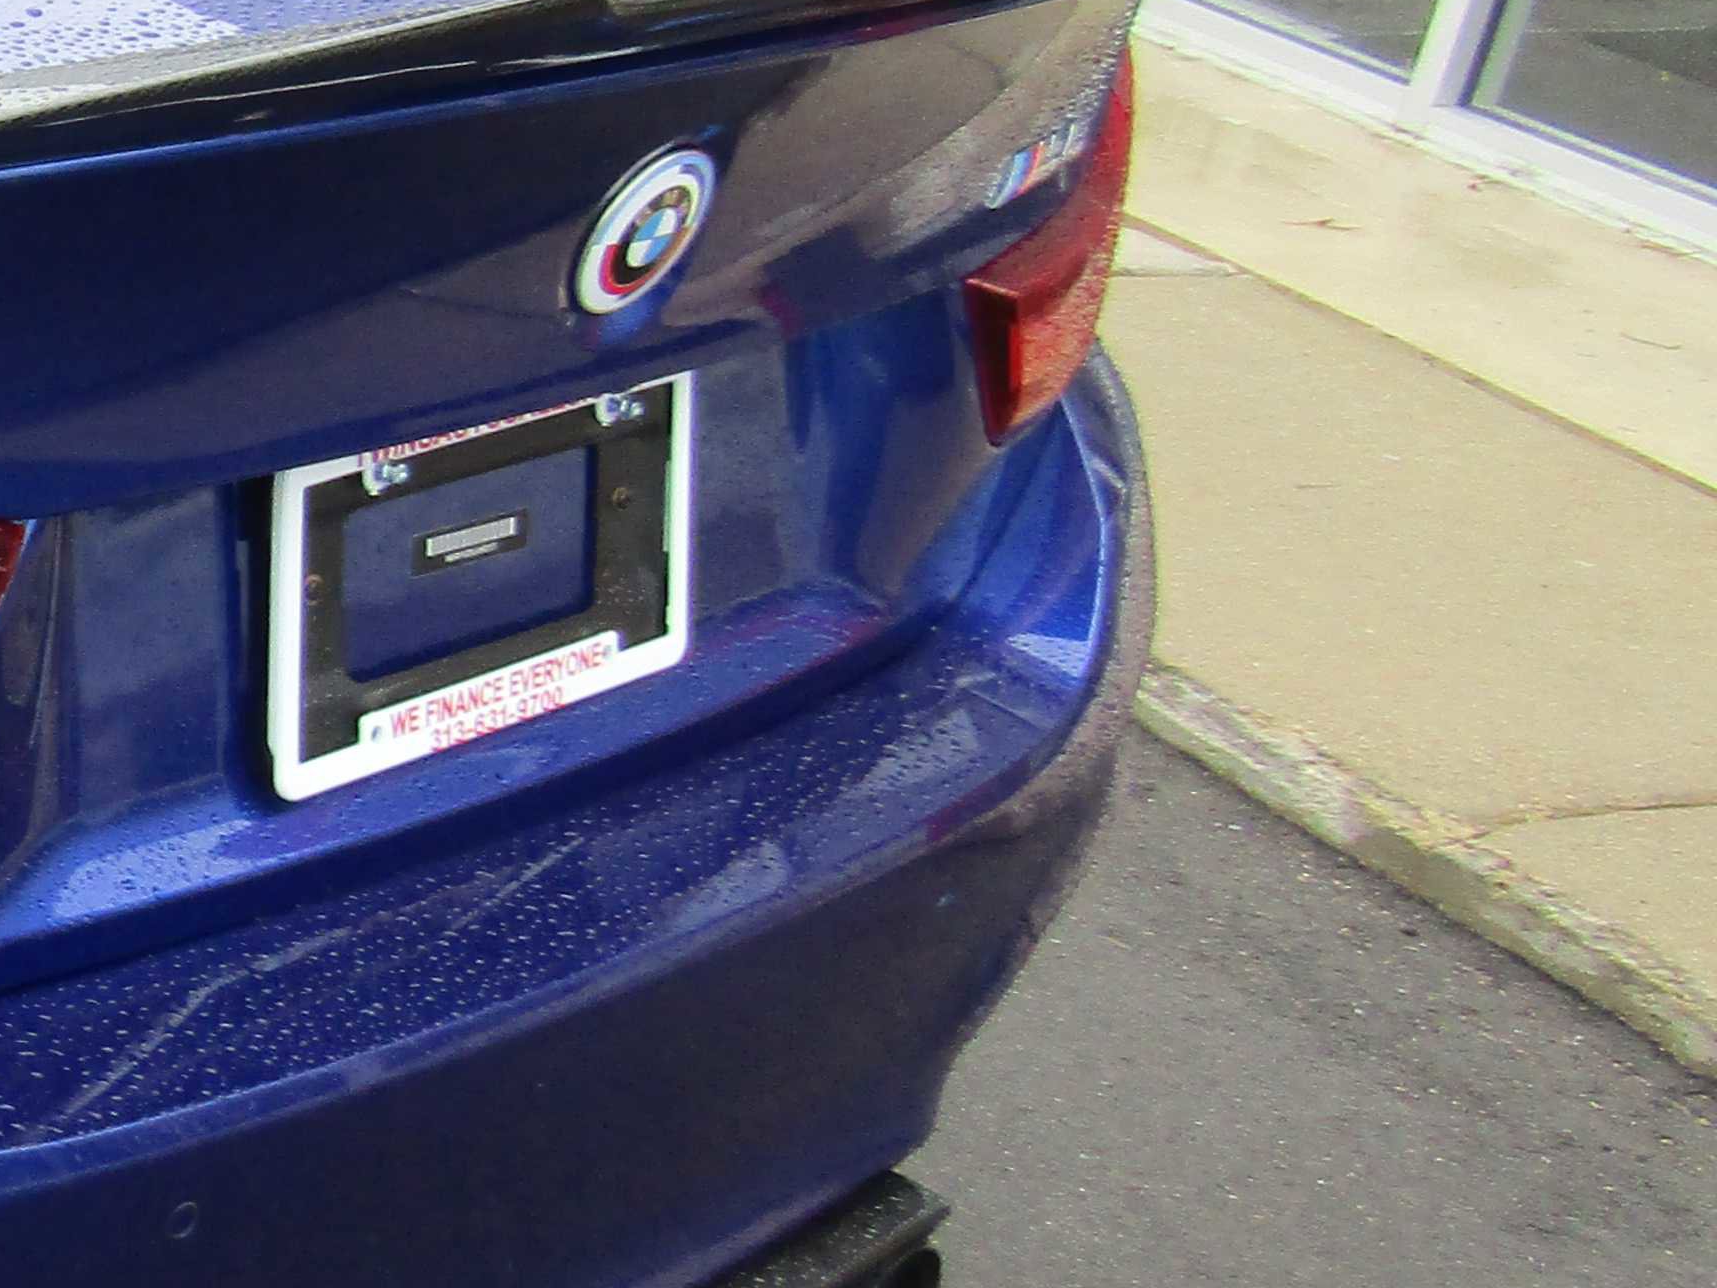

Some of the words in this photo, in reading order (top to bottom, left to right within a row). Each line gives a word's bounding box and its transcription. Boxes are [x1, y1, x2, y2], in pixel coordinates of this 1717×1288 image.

[390, 706, 421, 739] WE
[424, 676, 505, 723] FINANCE
[509, 641, 603, 697] EVERYONE
[430, 686, 566, 754] 313-631-9700
